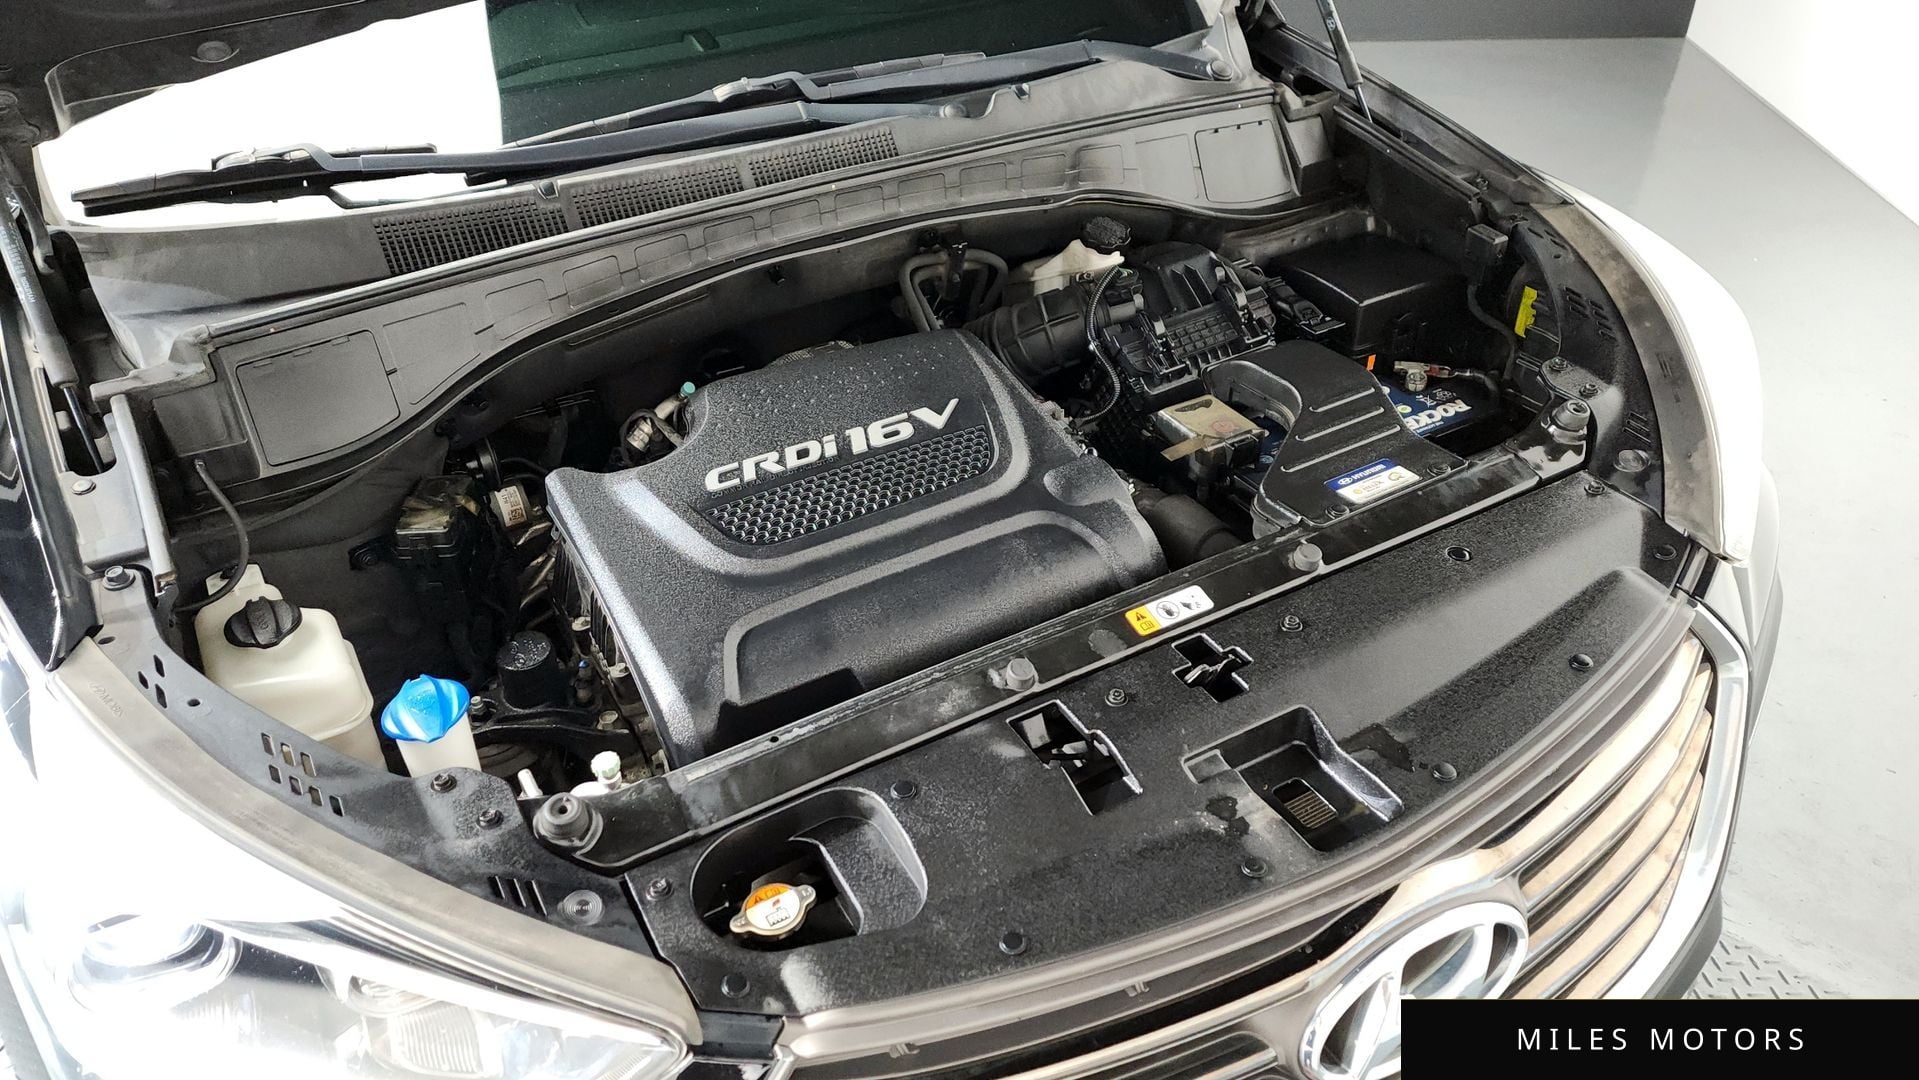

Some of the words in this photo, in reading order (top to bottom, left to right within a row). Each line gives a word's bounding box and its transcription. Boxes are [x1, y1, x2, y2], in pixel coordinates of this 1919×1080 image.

[1403, 399, 1472, 430] ROCKE
[705, 434, 838, 492] CRDi
[845, 398, 960, 456] 16V
[1351, 463, 1387, 480] HYUNDAI
